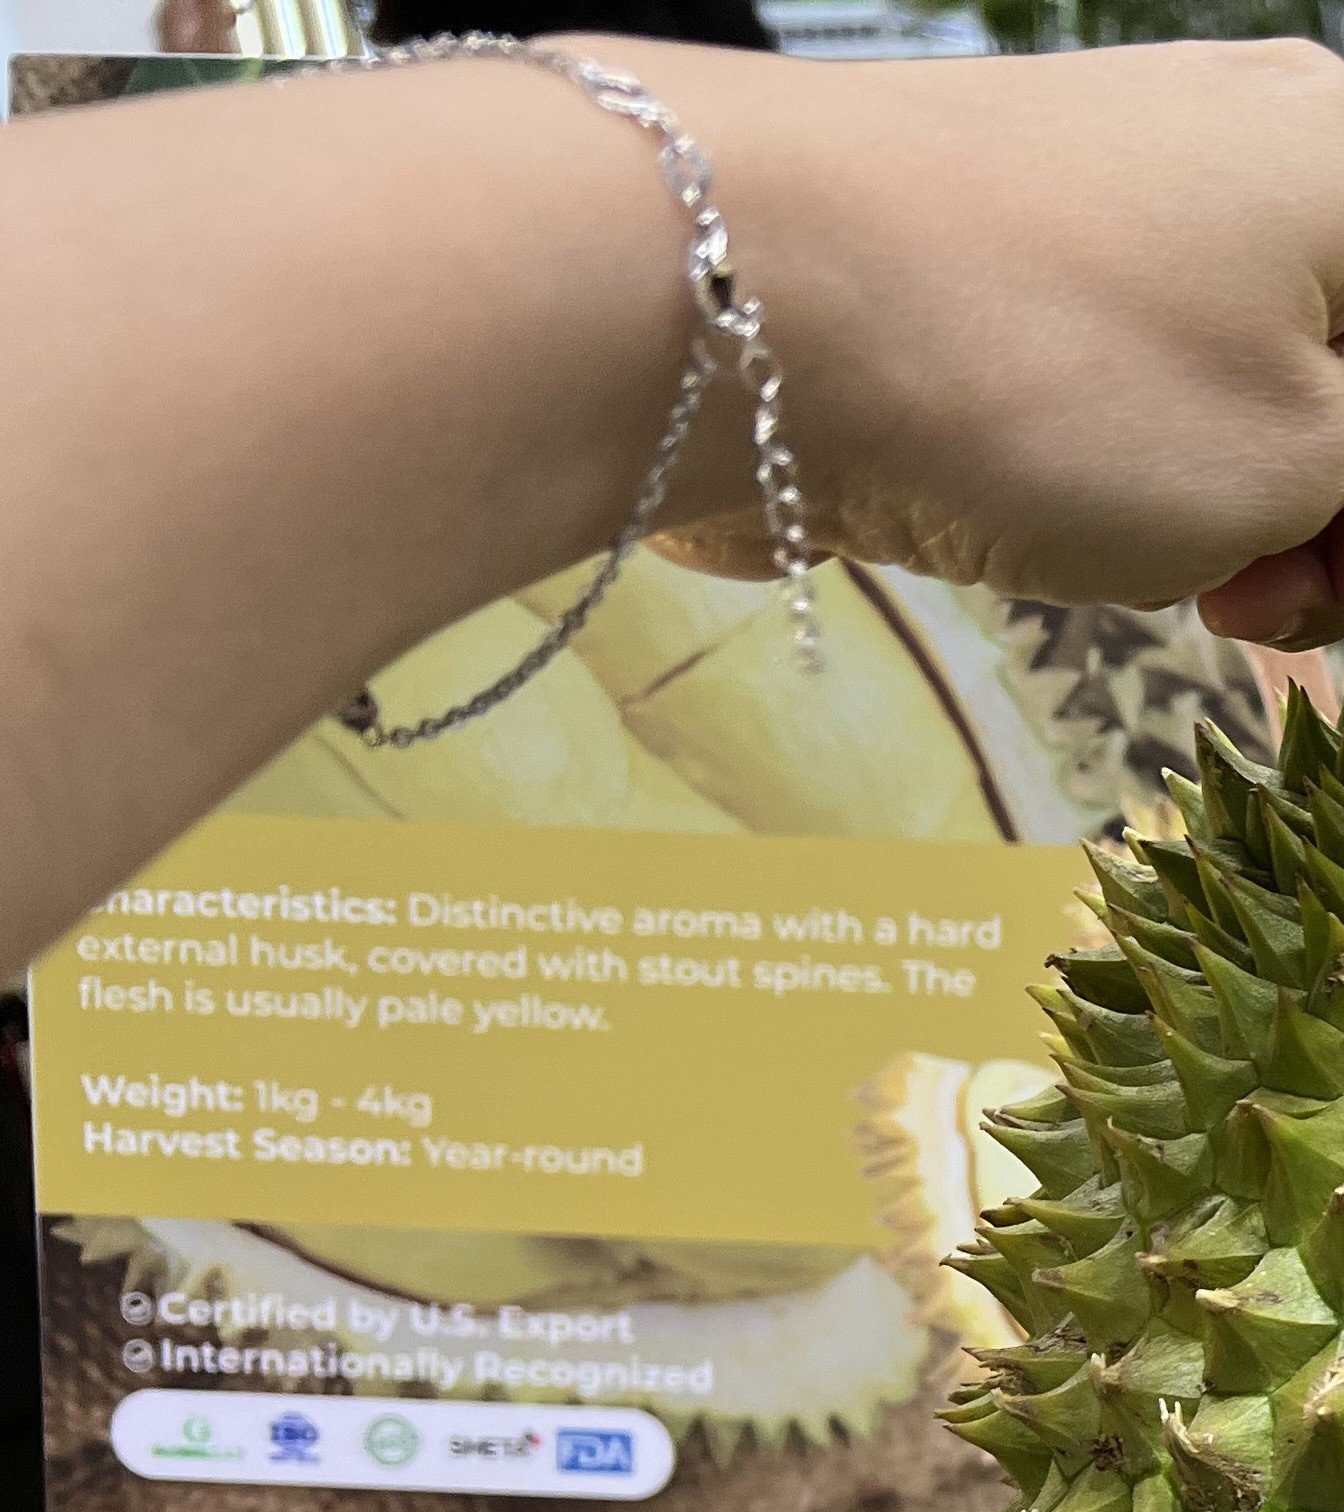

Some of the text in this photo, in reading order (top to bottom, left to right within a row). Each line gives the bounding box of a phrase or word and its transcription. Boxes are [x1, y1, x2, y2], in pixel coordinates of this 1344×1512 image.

[92, 885, 1002, 950] haracteristics: Distinctive aroma with a hard
[76, 932, 977, 998] external husk, covered with stout spines. The
[77, 975, 612, 1034] flesh is usually pale yellow.
[81, 1072, 245, 1118] Weight:
[253, 1078, 320, 1123] 1kg
[355, 1085, 434, 1128] 4kg
[82, 1121, 646, 1178] Harvest Season: Year-round
[158, 1292, 634, 1349] Certified by U.S. Export
[160, 1337, 714, 1397] Internationally Recognized
